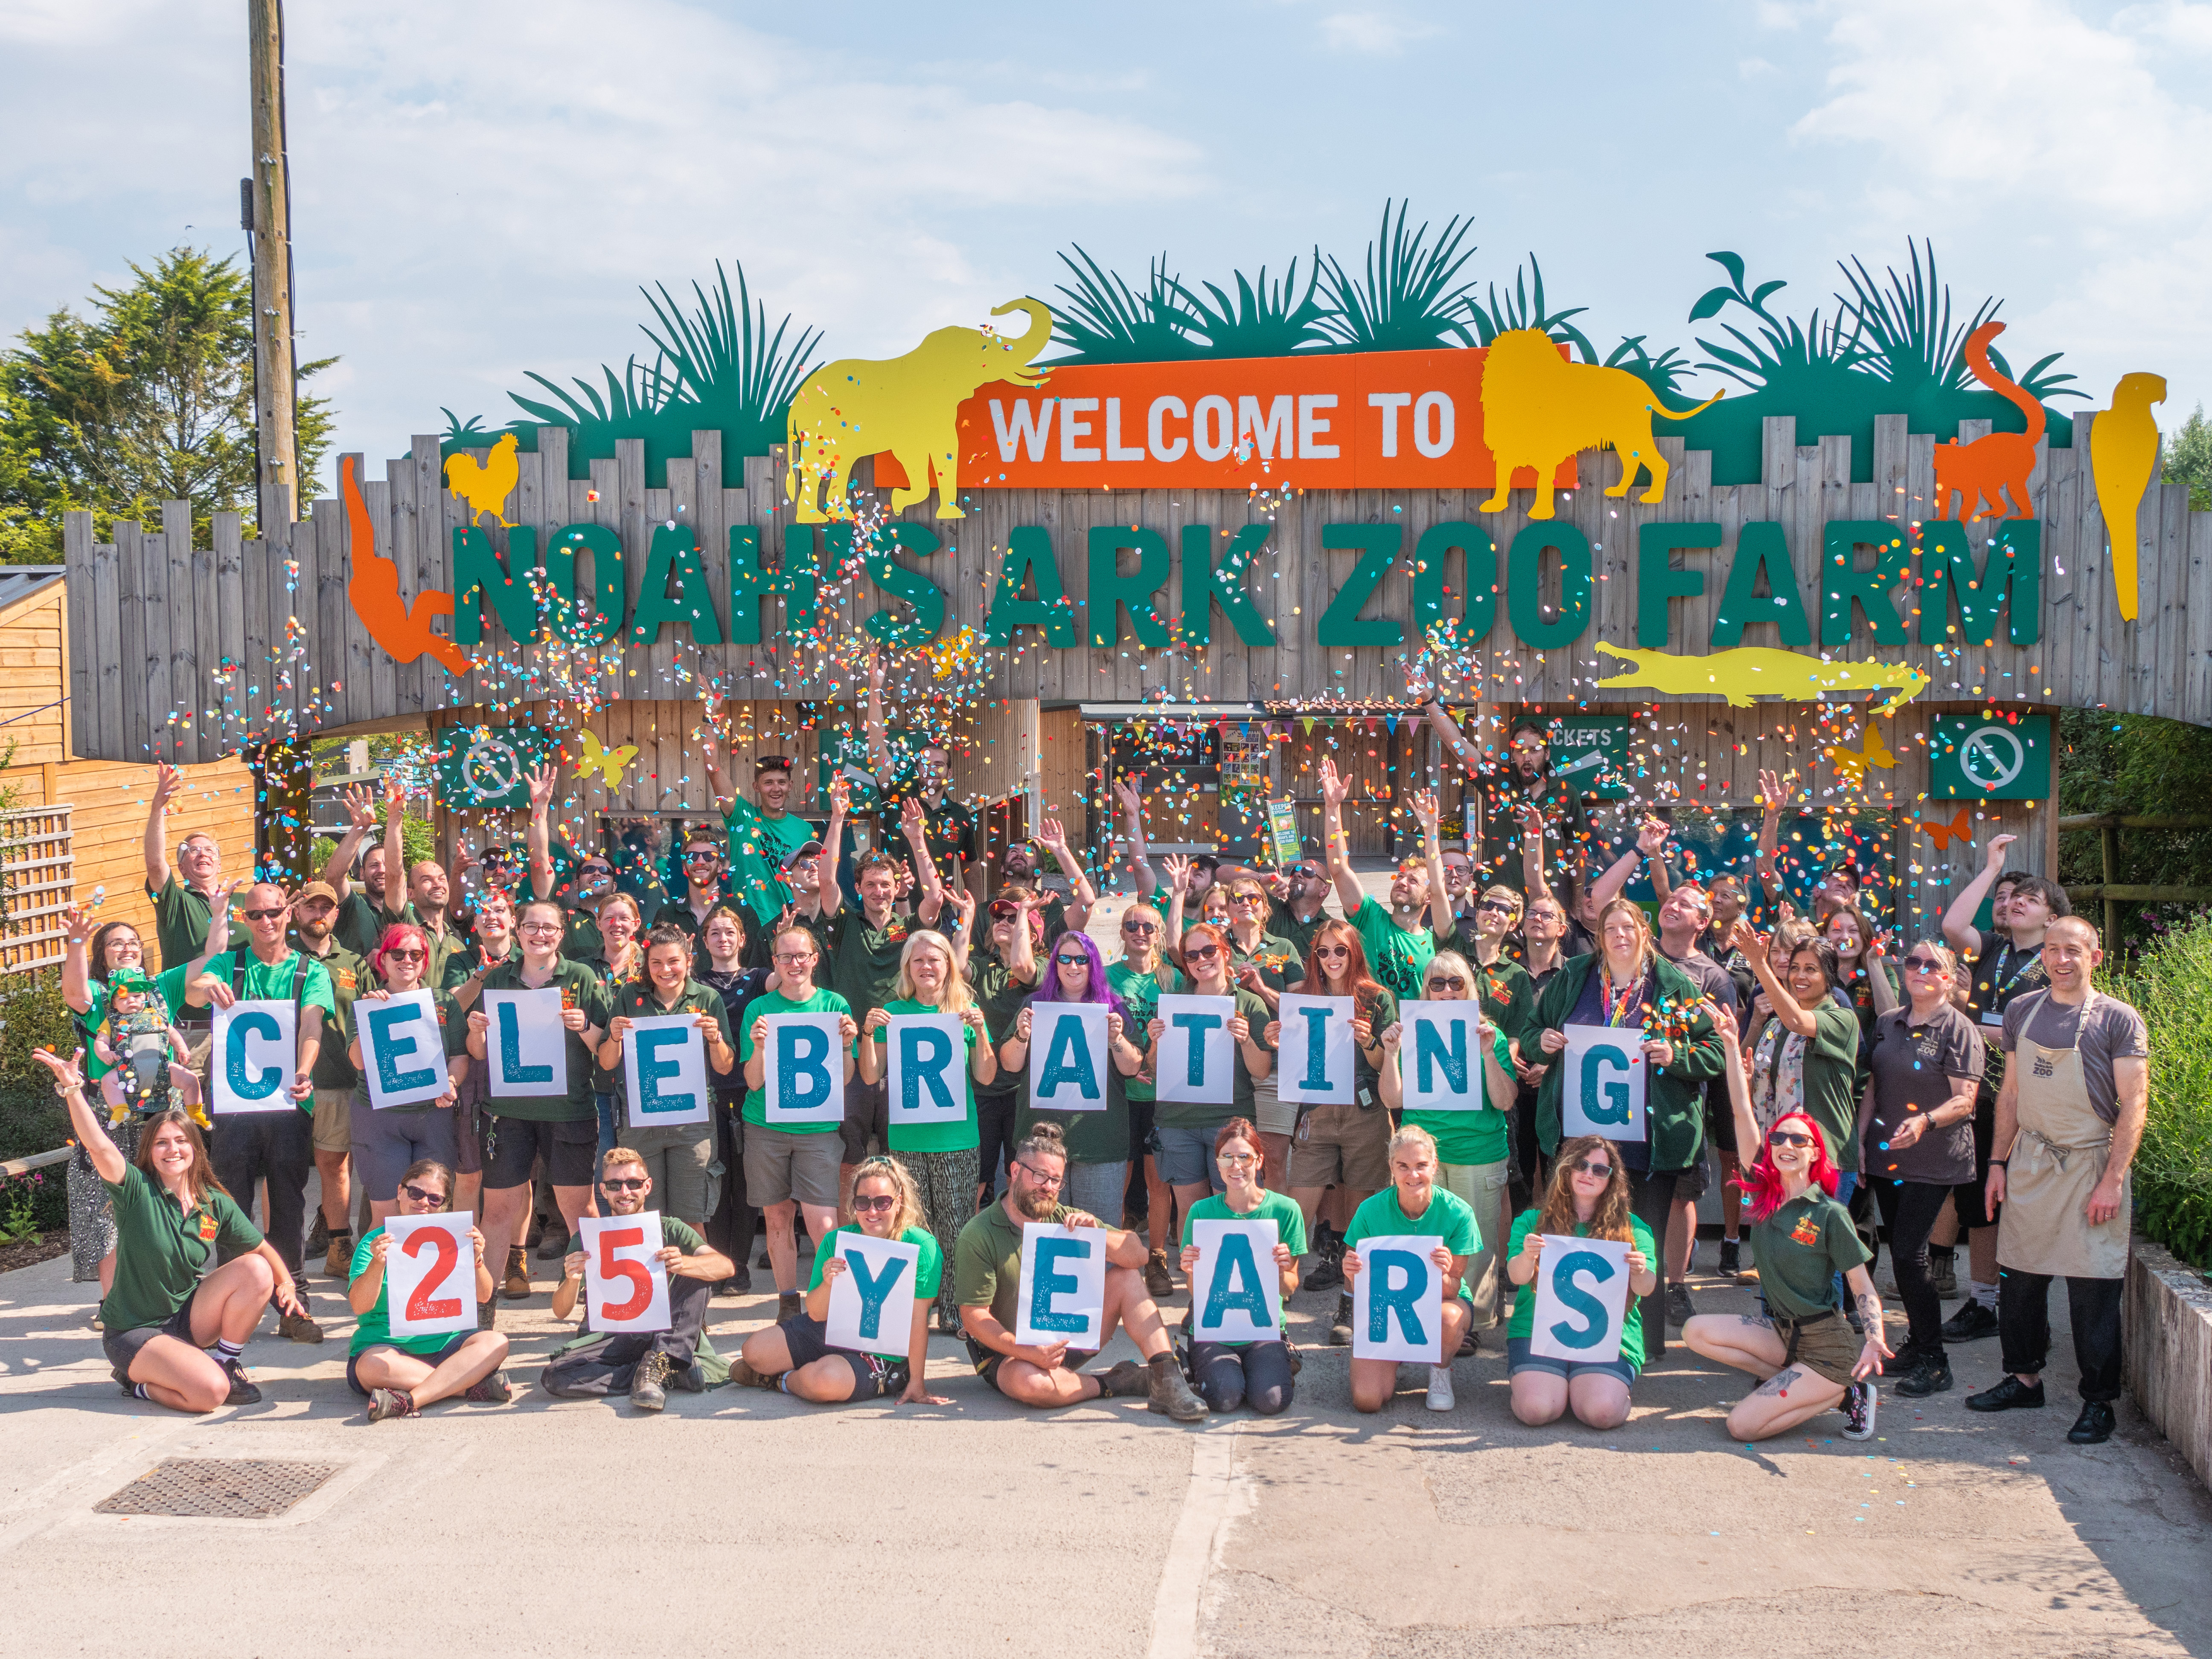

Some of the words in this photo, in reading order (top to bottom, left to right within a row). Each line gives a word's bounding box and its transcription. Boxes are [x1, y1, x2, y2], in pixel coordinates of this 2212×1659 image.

[989, 394, 1340, 462] WELCOME
[1368, 391, 1455, 458] TO
[453, 522, 945, 646] NOAH'S
[985, 524, 1276, 648] ARK
[1318, 520, 1592, 649] ZOO
[1638, 519, 2040, 646] FARM
[1545, 728, 1611, 746] ICKETS
[1377, 961, 1410, 992] ZOO
[1401, 967, 1417, 978] Ark
[339, 978, 355, 988] ZOO
[562, 1001, 574, 1009] OO
[1917, 1045, 1936, 1056] ZOO
[2033, 1067, 2052, 1076] ZOO
[200, 1228, 215, 1239] ZOO
[1791, 1229, 1816, 1244] ZOO
